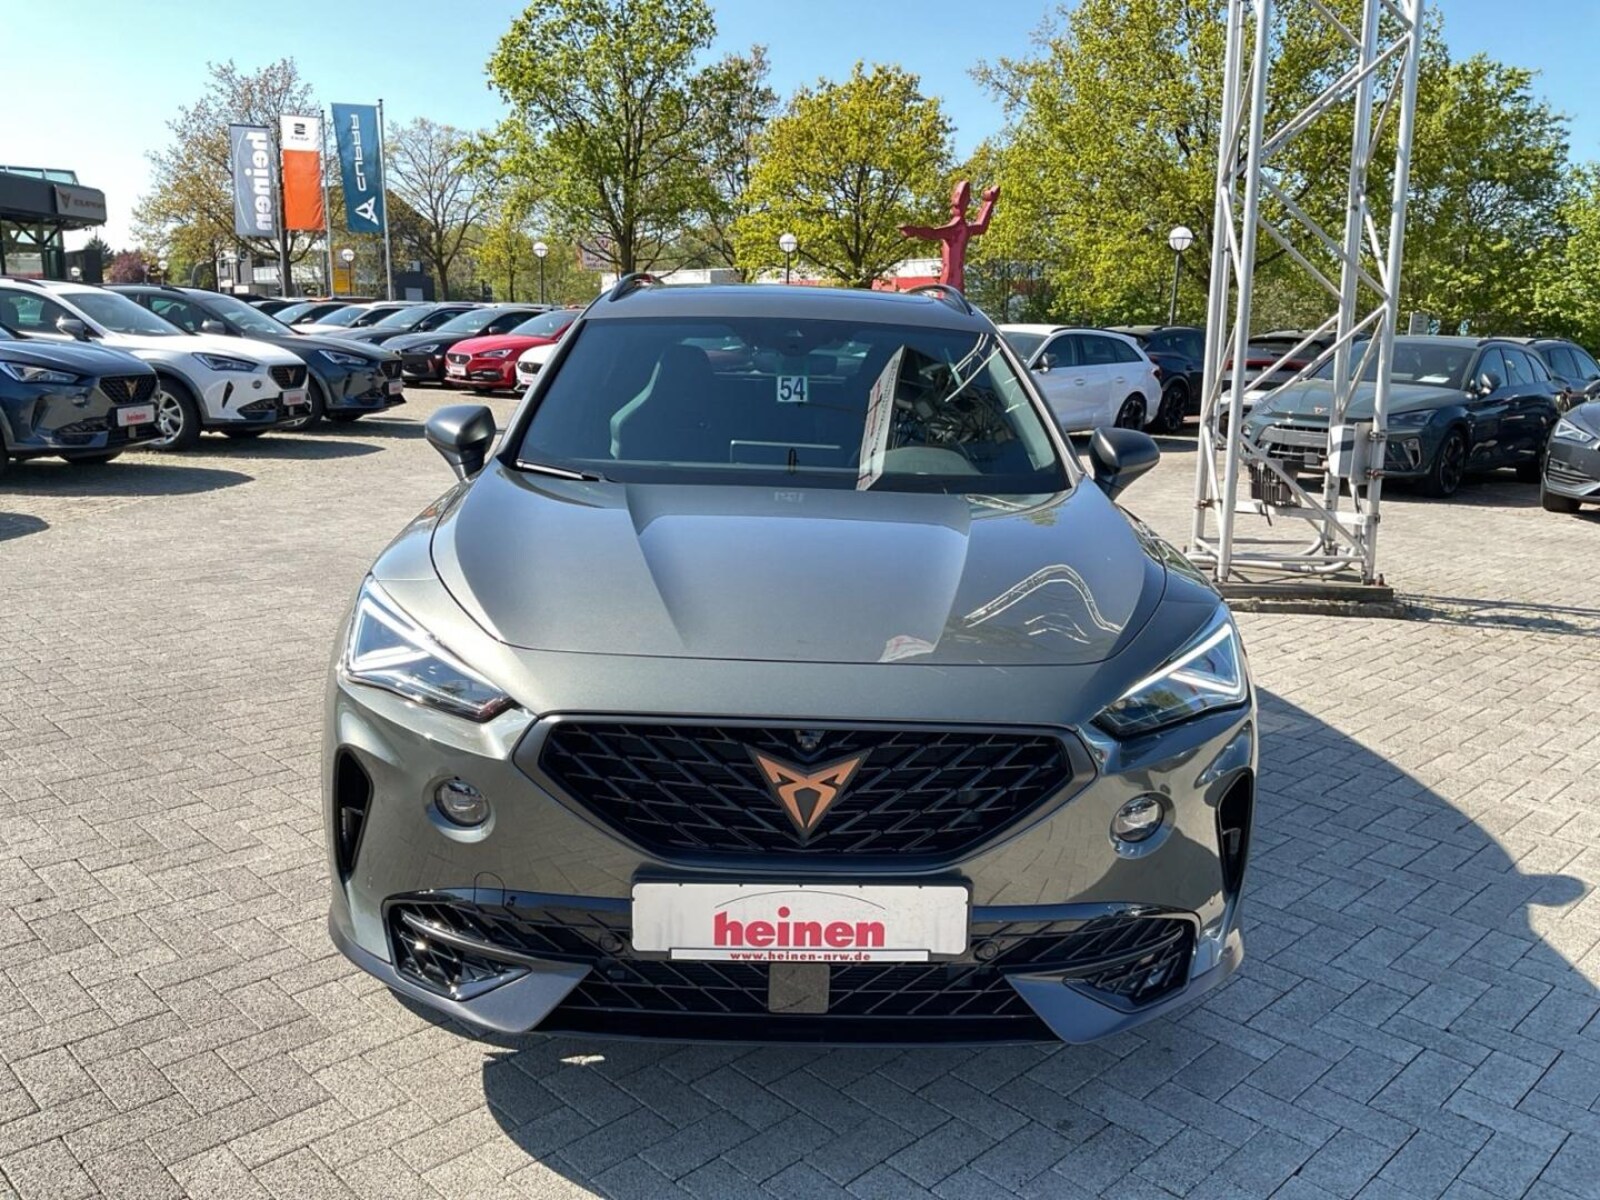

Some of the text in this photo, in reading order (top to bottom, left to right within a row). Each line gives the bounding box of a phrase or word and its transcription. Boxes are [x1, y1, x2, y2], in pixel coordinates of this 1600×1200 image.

[780, 377, 805, 401] 54
[714, 906, 885, 948] heinen
[730, 951, 871, 961] www.heinen-nrw.de
